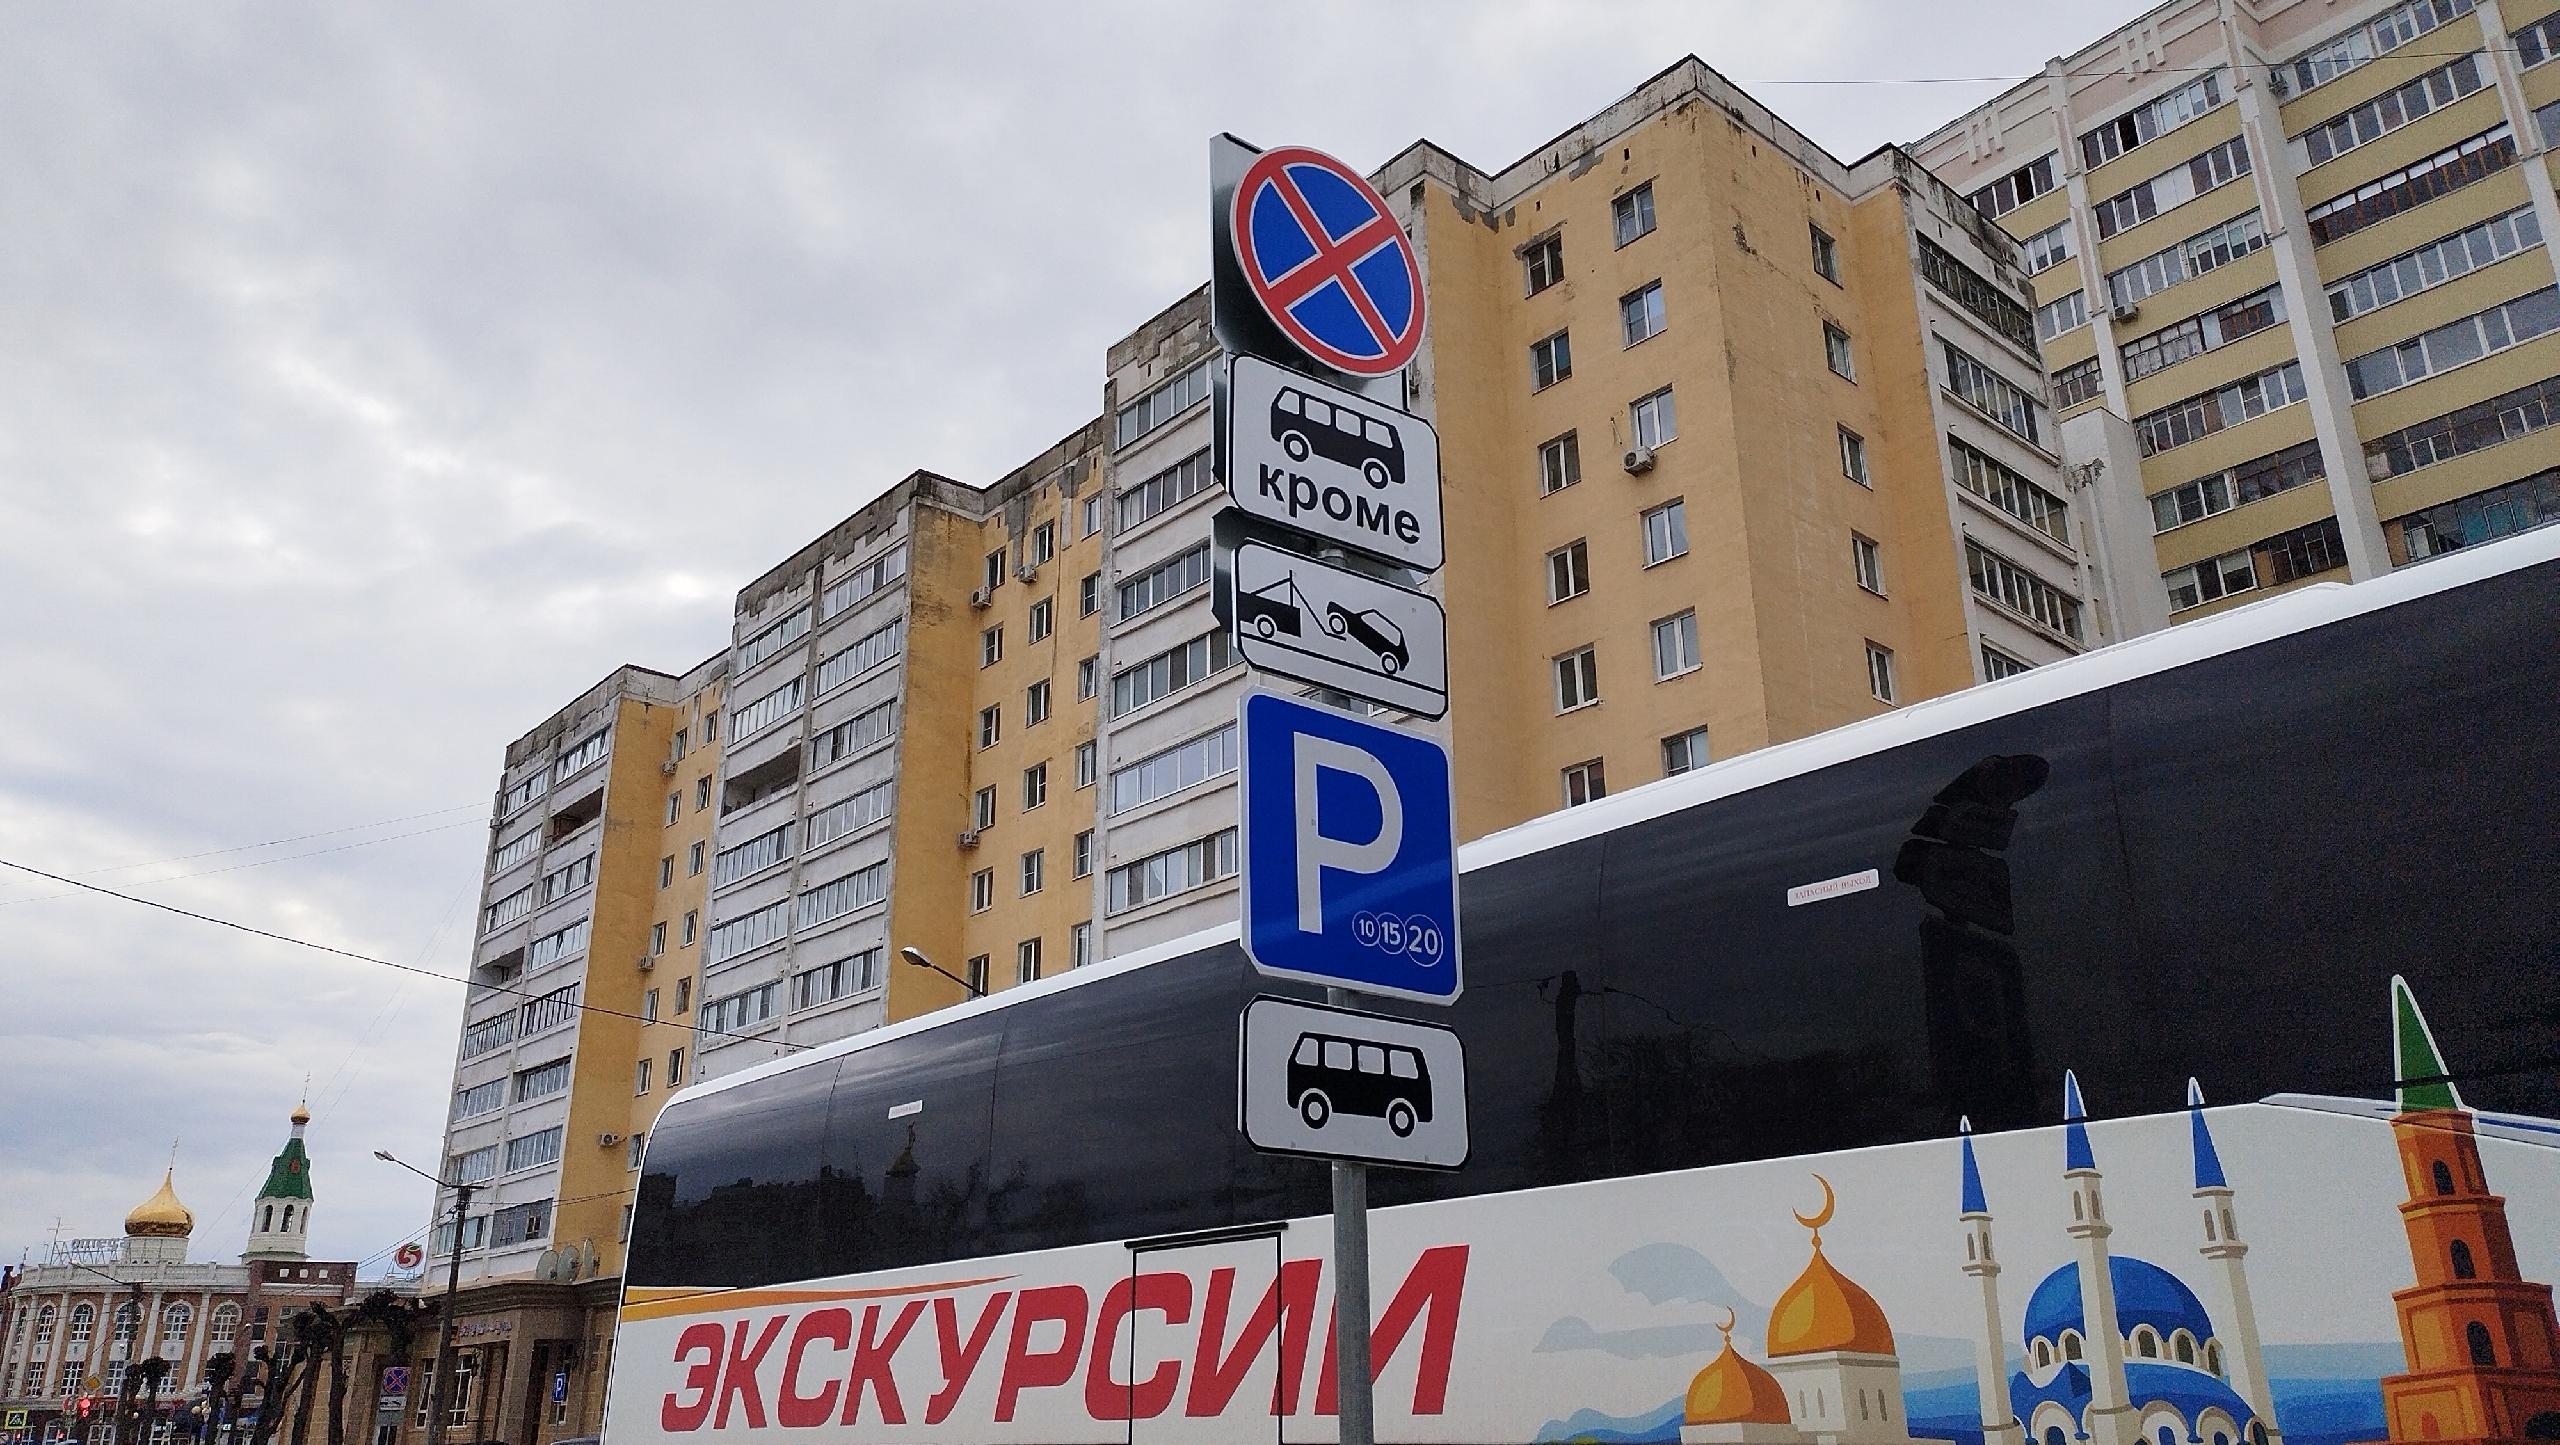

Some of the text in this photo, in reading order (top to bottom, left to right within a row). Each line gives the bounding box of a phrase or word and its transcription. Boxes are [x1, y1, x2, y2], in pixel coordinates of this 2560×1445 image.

[1259, 462, 1420, 544] кроме
[1293, 731, 1403, 934] P
[1358, 918, 1438, 955] 10 15 20
[661, 1244, 1471, 1433] ЭКСКУРСИИ
